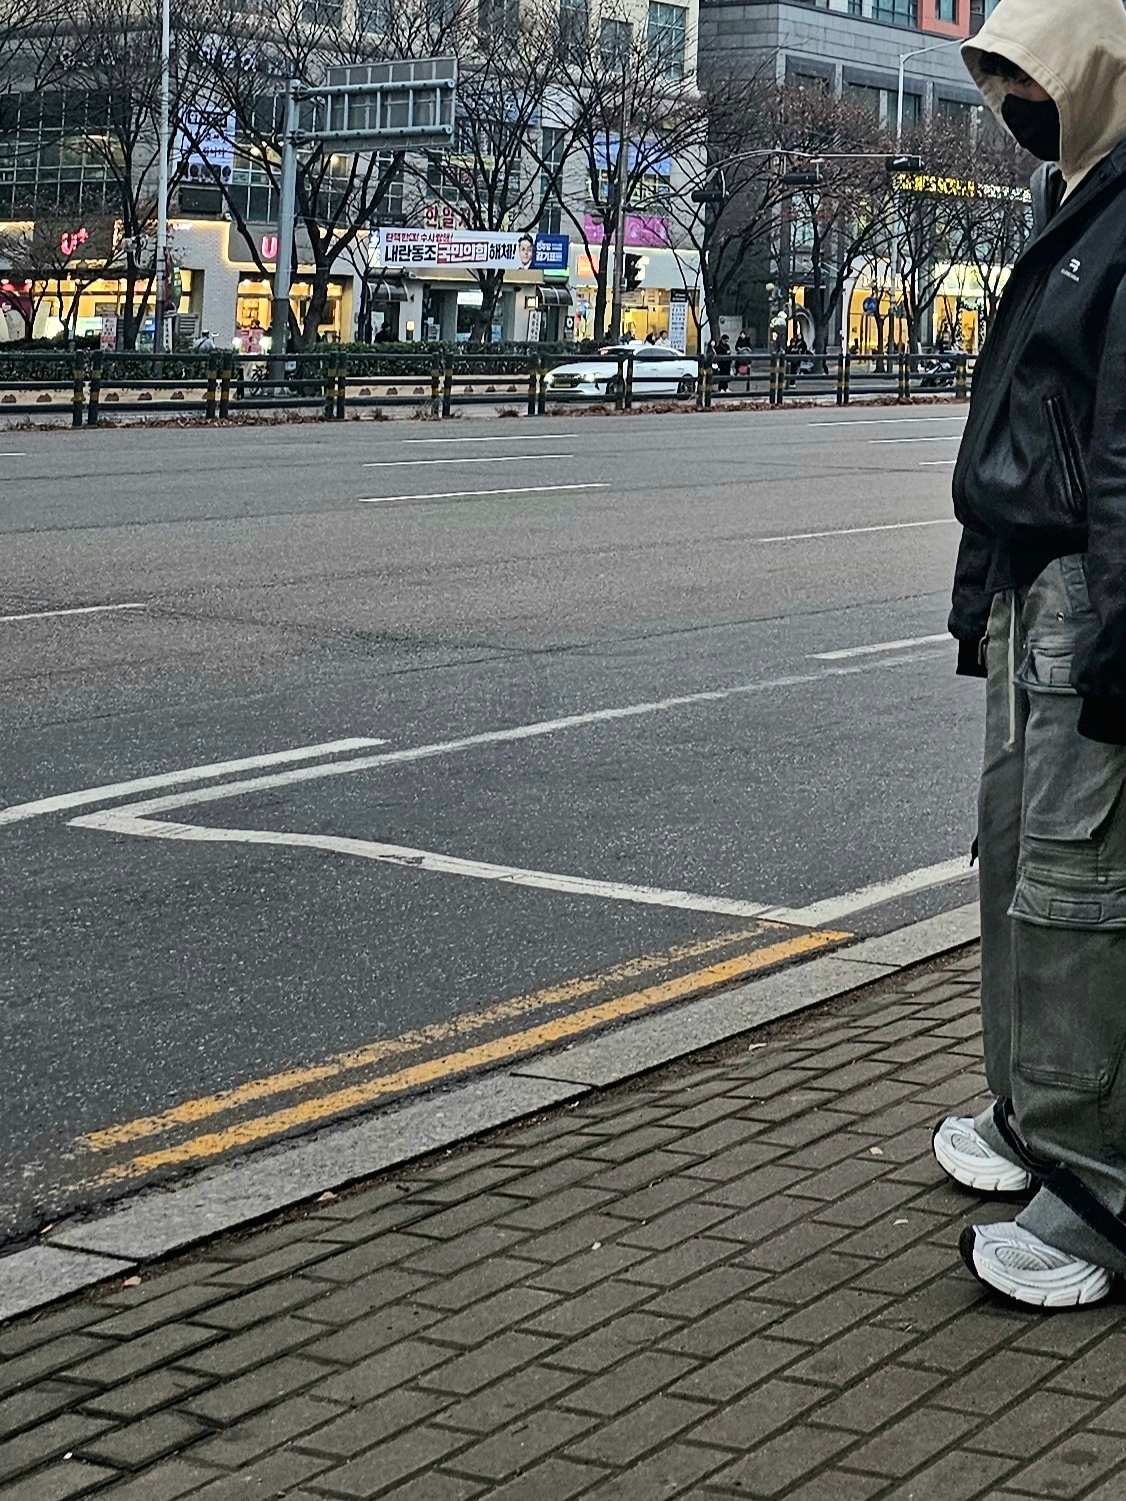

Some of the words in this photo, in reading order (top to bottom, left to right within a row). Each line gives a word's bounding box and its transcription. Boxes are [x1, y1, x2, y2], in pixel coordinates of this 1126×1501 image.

[385, 244, 436, 262] 내란동조
[437, 243, 487, 263] 국민의힘
[489, 243, 517, 261] 해체!
